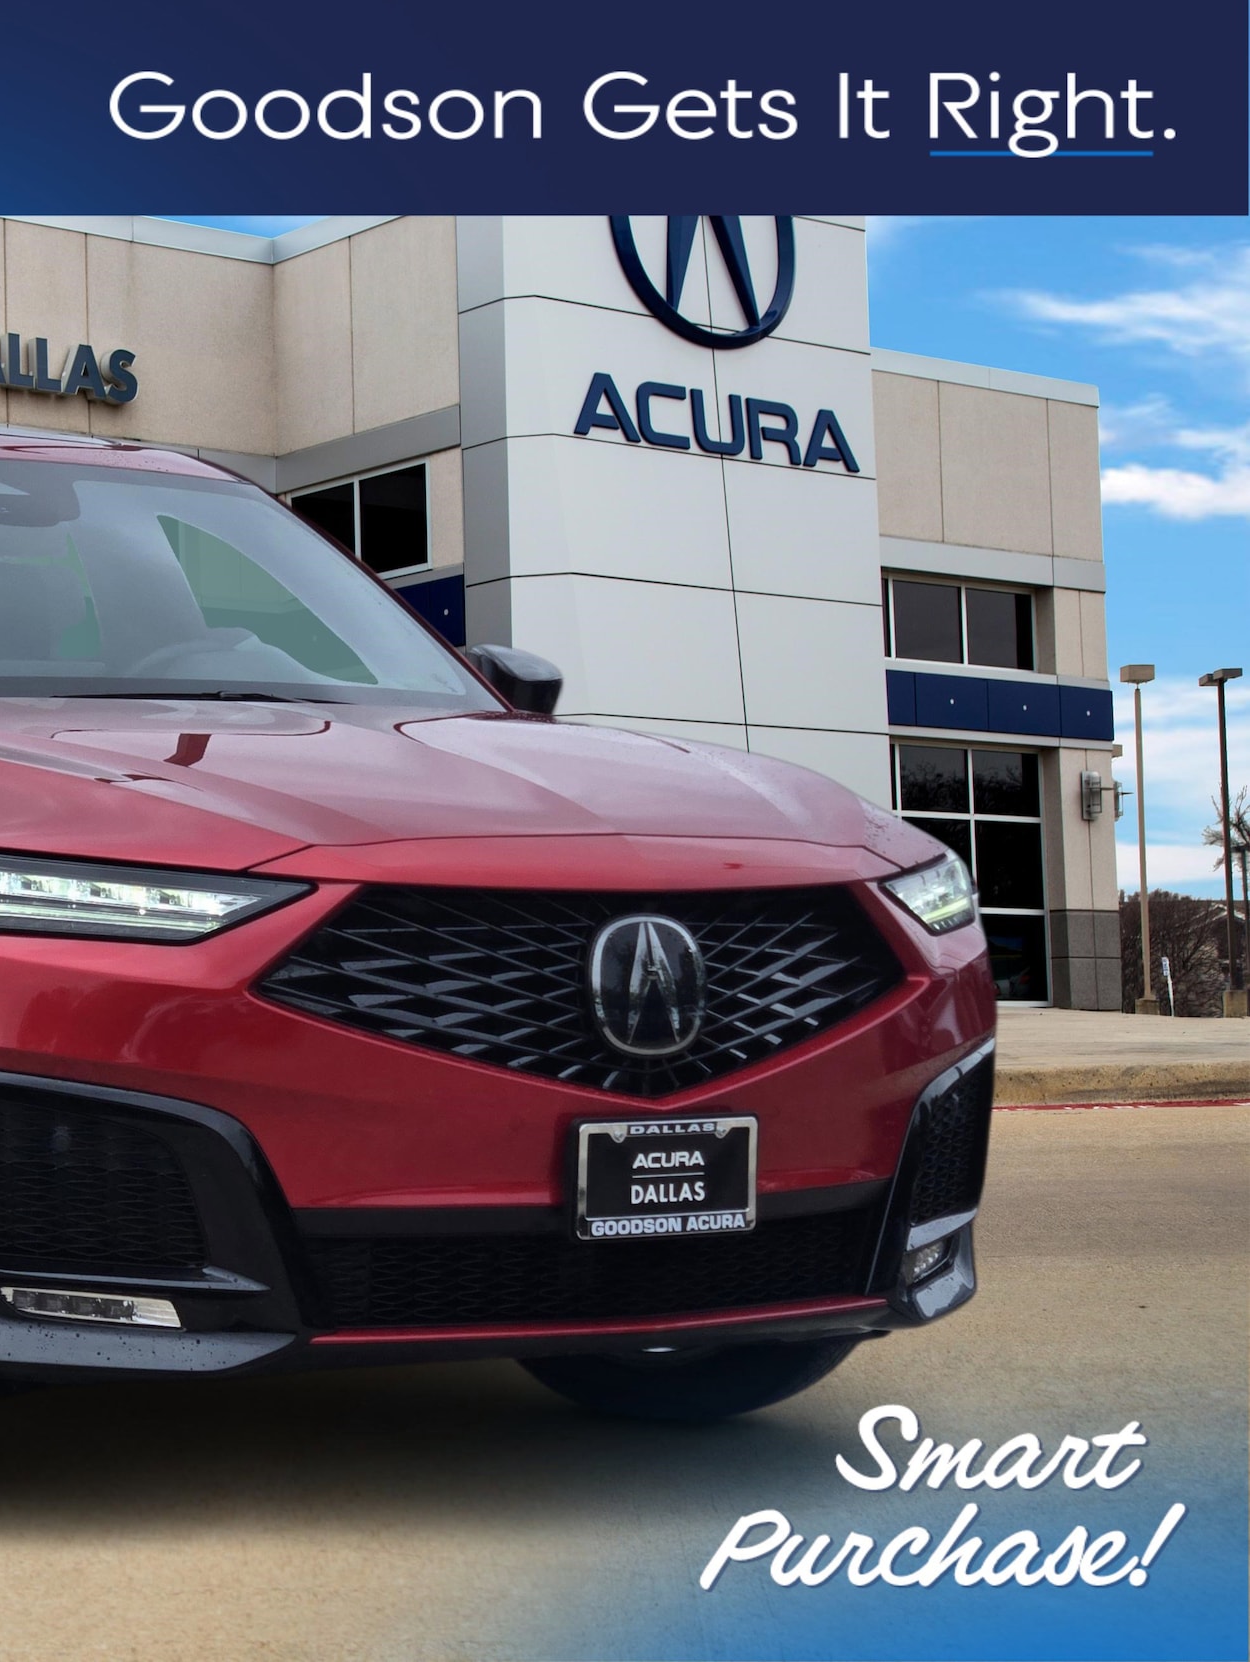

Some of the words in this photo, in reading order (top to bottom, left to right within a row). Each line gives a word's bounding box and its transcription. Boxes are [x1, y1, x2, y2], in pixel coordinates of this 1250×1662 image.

[573, 371, 860, 473] ACURA
[629, 1122, 716, 1136] DALLAS
[632, 1150, 705, 1169] ACURA
[630, 1181, 706, 1205] DALLAS
[591, 1217, 682, 1237] GOODSON
[686, 1213, 746, 1232] ACURA
